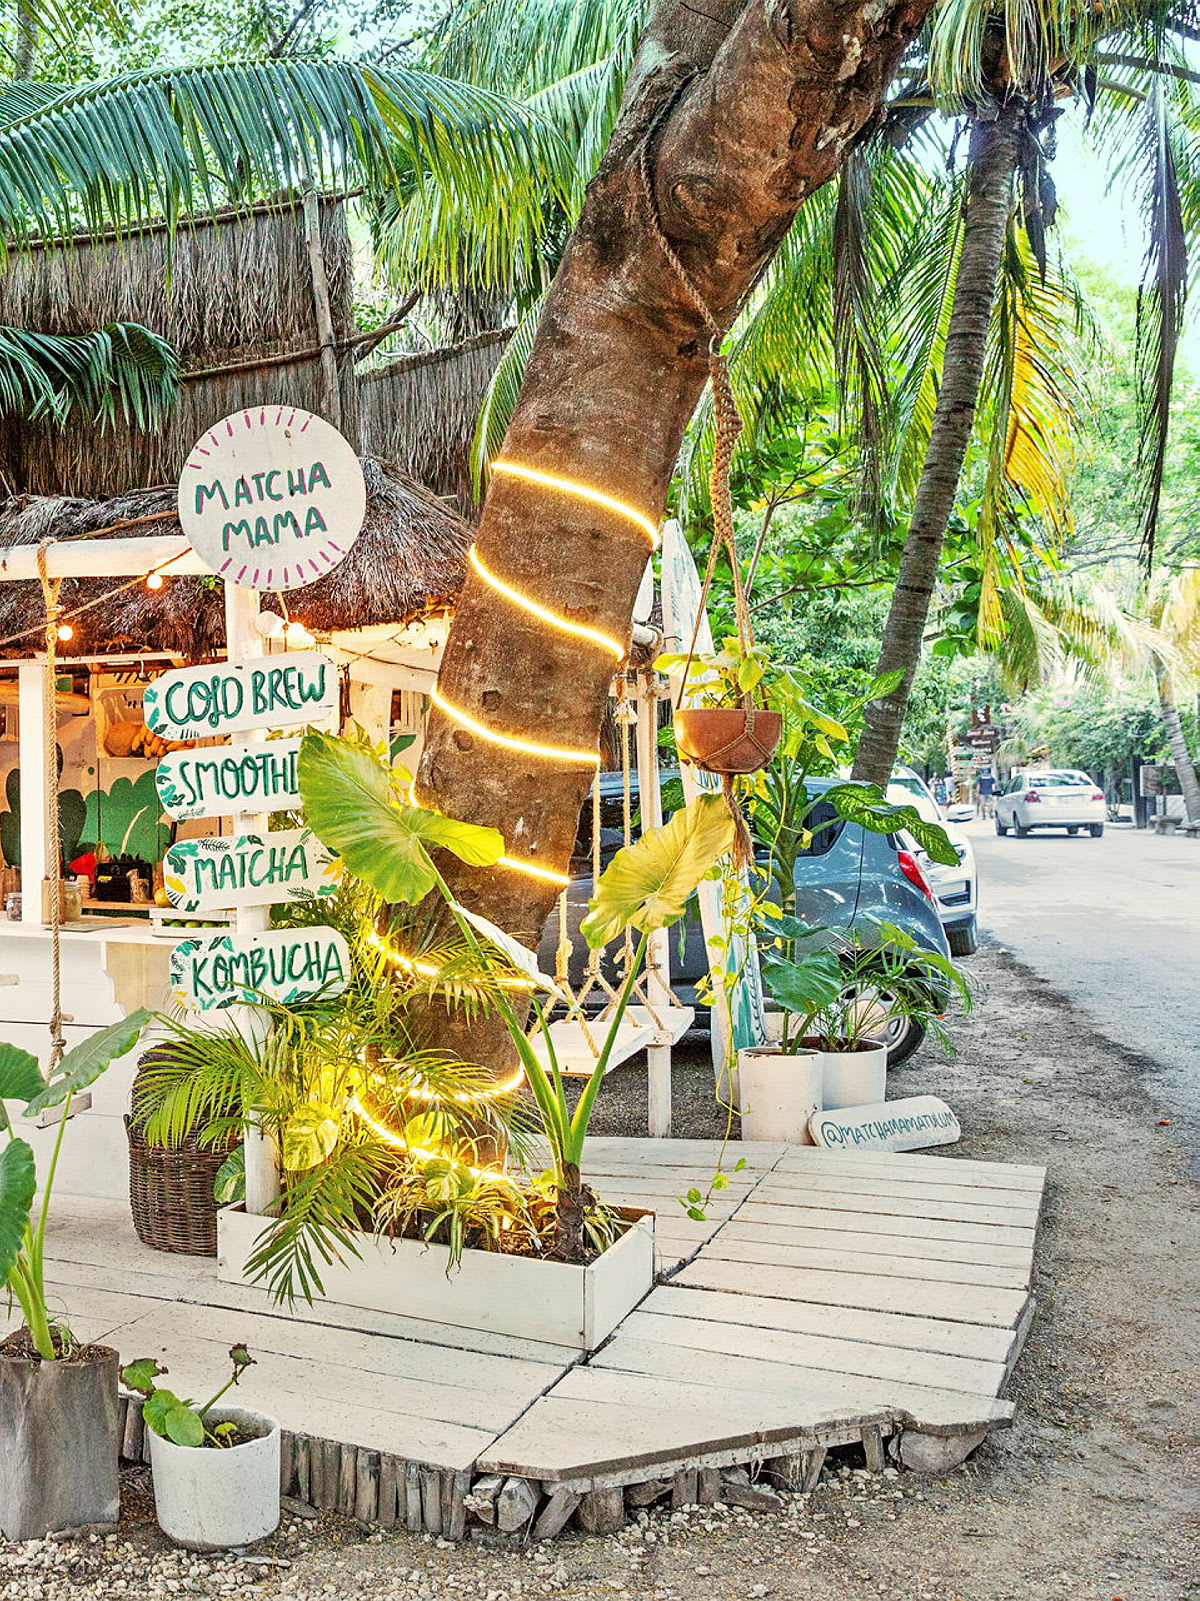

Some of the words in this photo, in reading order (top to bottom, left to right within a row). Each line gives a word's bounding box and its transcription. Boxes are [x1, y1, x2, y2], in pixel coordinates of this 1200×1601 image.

[195, 461, 332, 515] MATCHA
[222, 506, 328, 551] MAMA
[165, 675, 243, 728] COLD
[251, 664, 326, 714] BREW
[179, 750, 299, 806] SMOOTHI
[194, 845, 309, 894] MATCHA
[191, 940, 345, 997] KOMBUCHA
